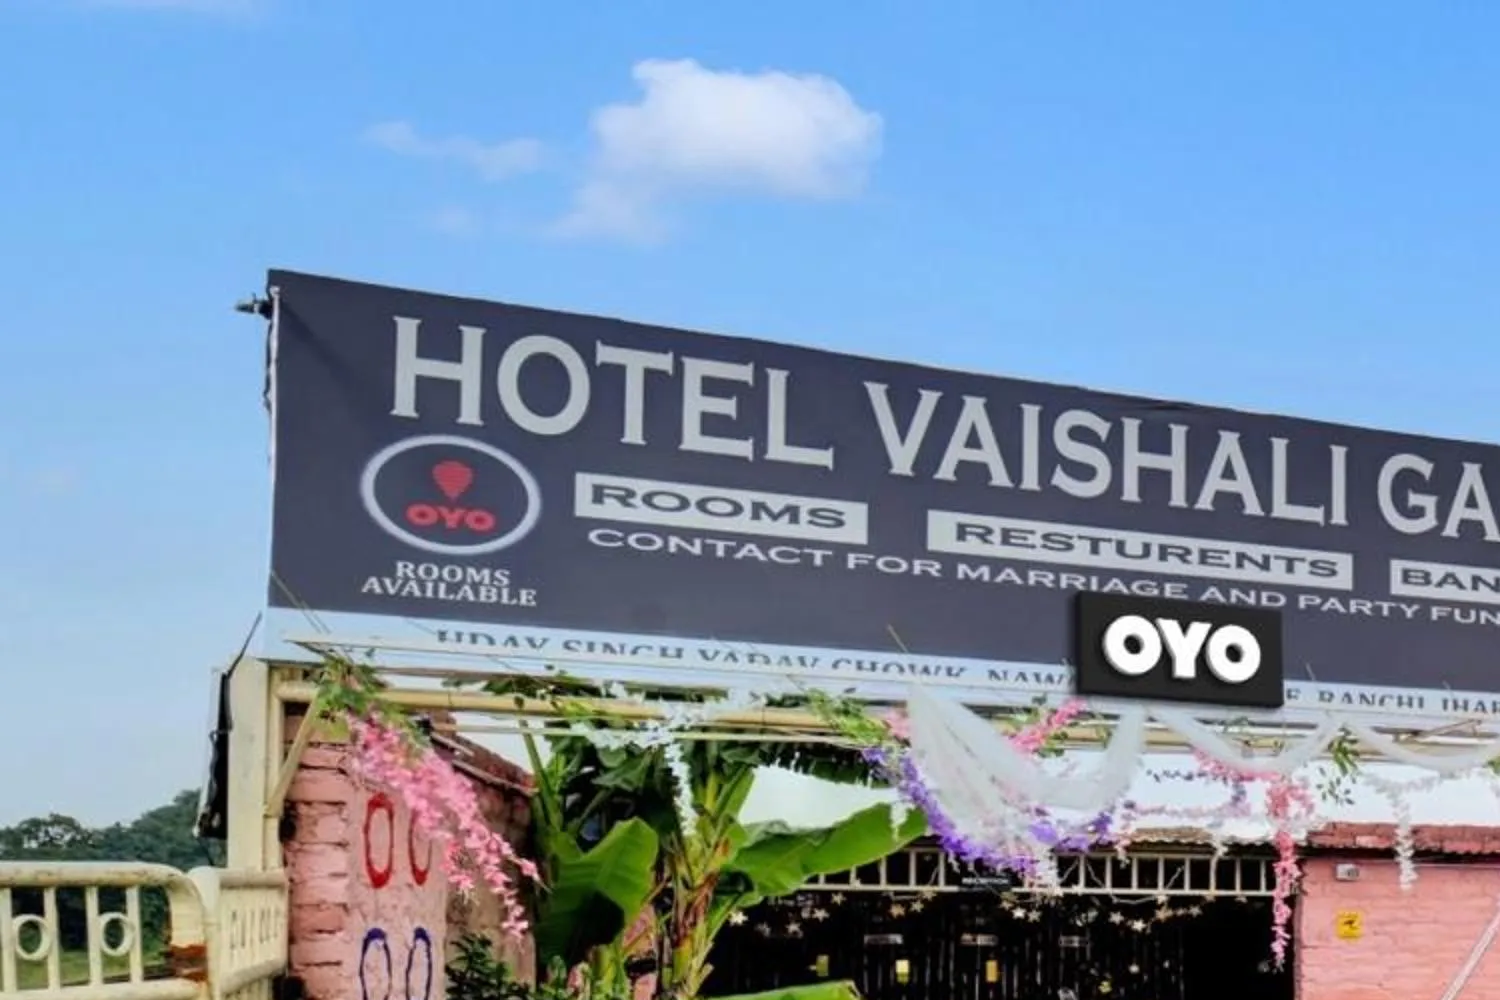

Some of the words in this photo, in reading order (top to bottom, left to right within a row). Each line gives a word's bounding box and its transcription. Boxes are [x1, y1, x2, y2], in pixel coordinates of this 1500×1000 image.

[390, 315, 835, 472] HOTEL
[862, 380, 1349, 526] VAISHALI
[407, 504, 496, 532] OYO
[590, 483, 846, 529] ROOMS
[396, 559, 512, 588] ROOMS
[588, 528, 833, 567] CONTACT
[847, 551, 942, 577] FOR
[957, 563, 1189, 600] MARRIAGE
[1200, 586, 1287, 608] AND
[1298, 595, 1420, 620] PARTY
[955, 522, 1339, 578] RESTURENTS
[361, 575, 537, 607] AVAILABLE
[1103, 614, 1262, 684] OYO
